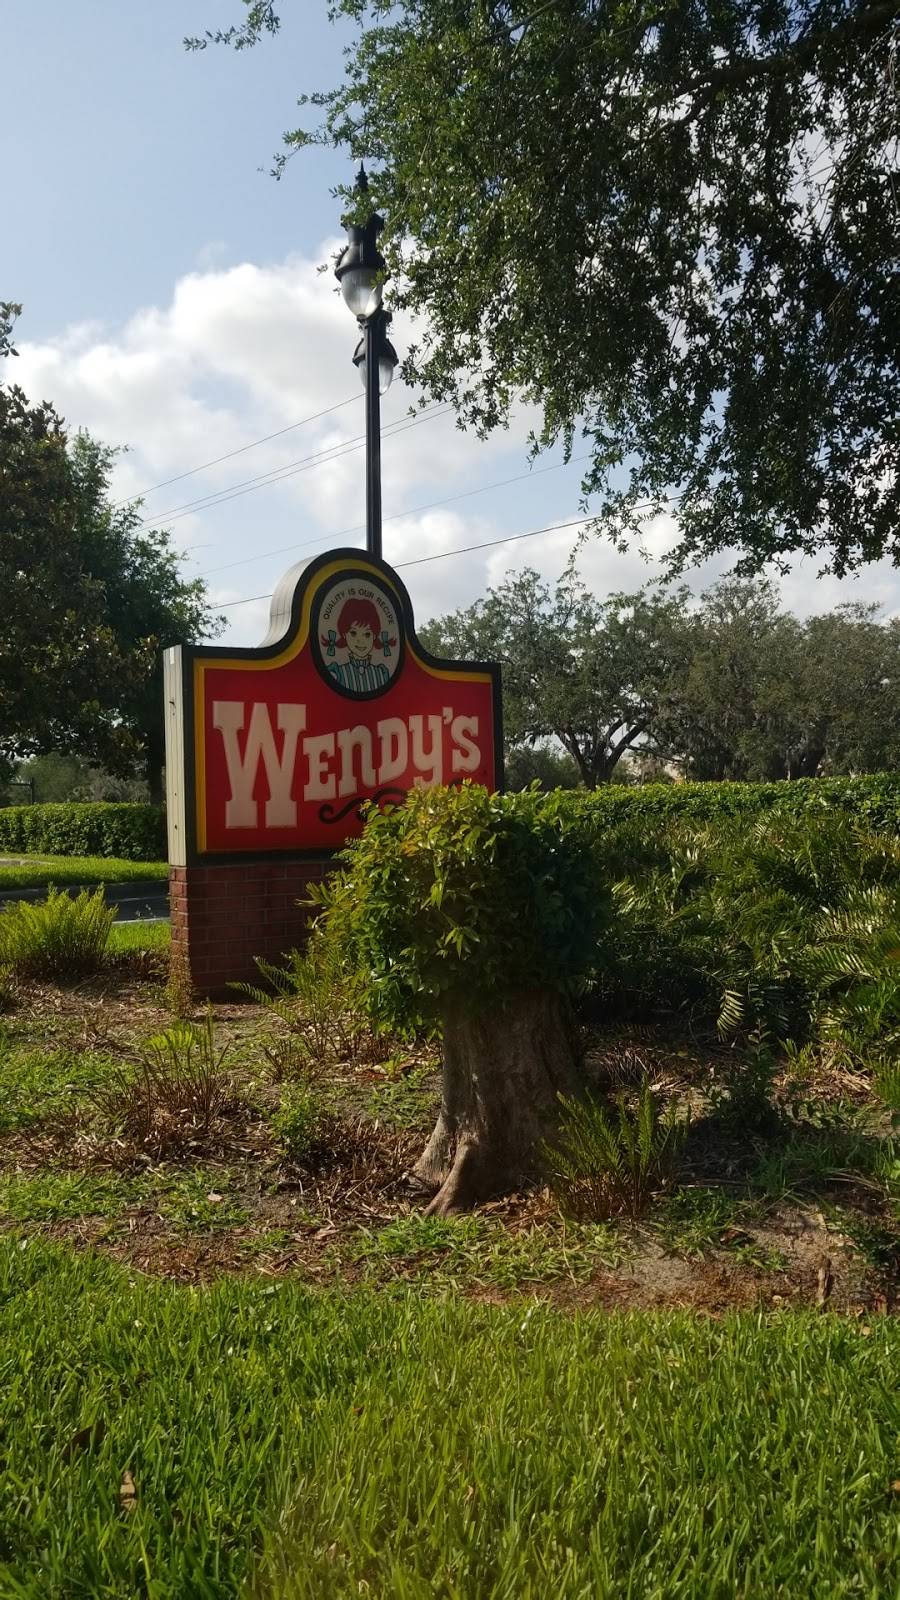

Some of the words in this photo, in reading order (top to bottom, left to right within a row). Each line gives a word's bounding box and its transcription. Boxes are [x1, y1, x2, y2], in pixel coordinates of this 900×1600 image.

[323, 591, 345, 620] QUALITY
[348, 588, 356, 596] IS
[358, 588, 375, 599] OUR
[377, 597, 395, 625] RECIPE
